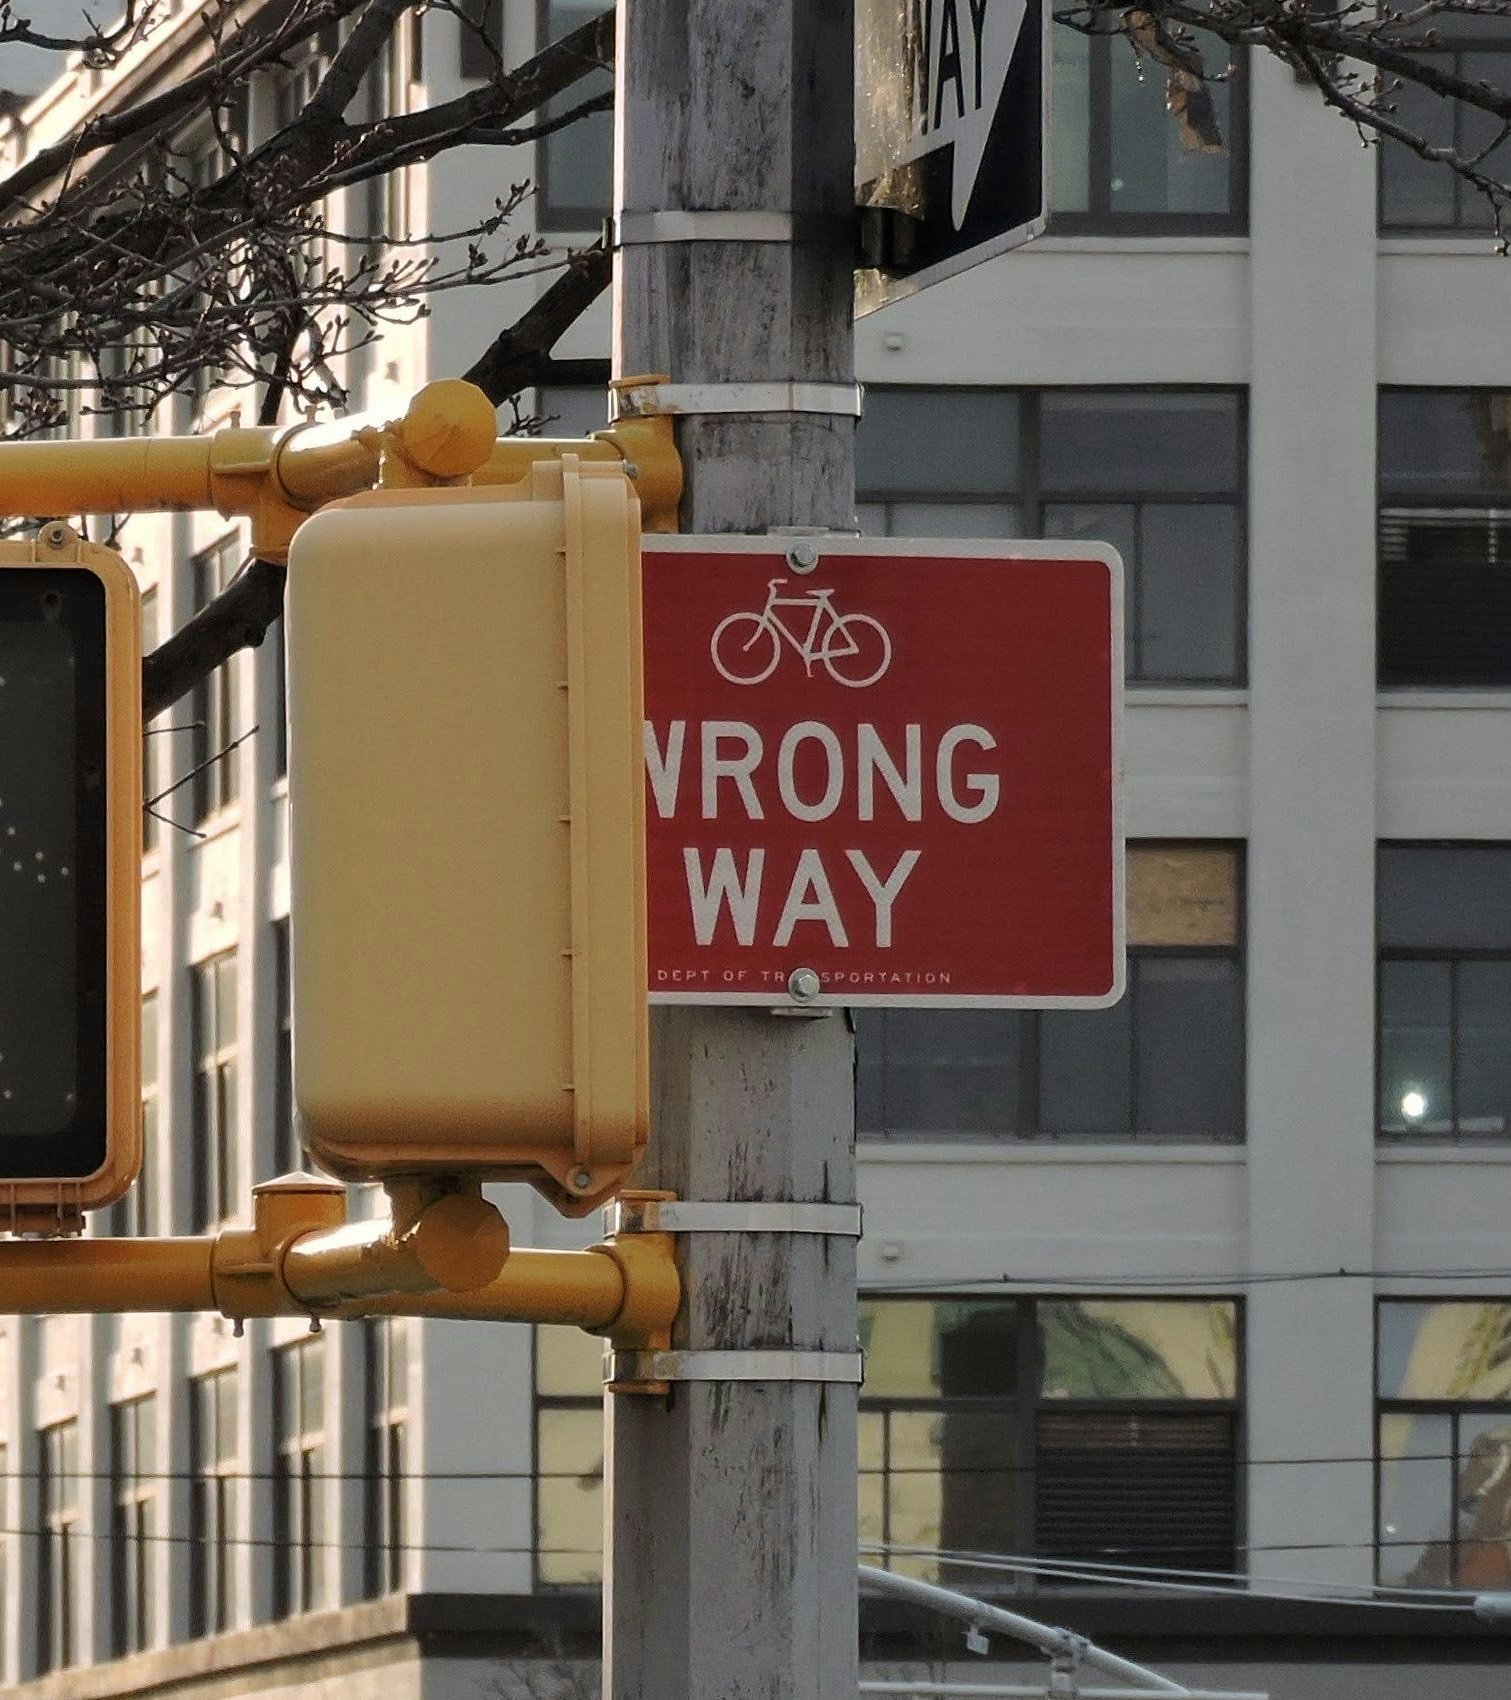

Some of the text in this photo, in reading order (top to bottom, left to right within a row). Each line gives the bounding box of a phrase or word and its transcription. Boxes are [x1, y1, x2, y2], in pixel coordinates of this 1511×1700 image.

[684, 847, 922, 948] WAY
[657, 969, 953, 984] DEPT OF TRSPORTATION
